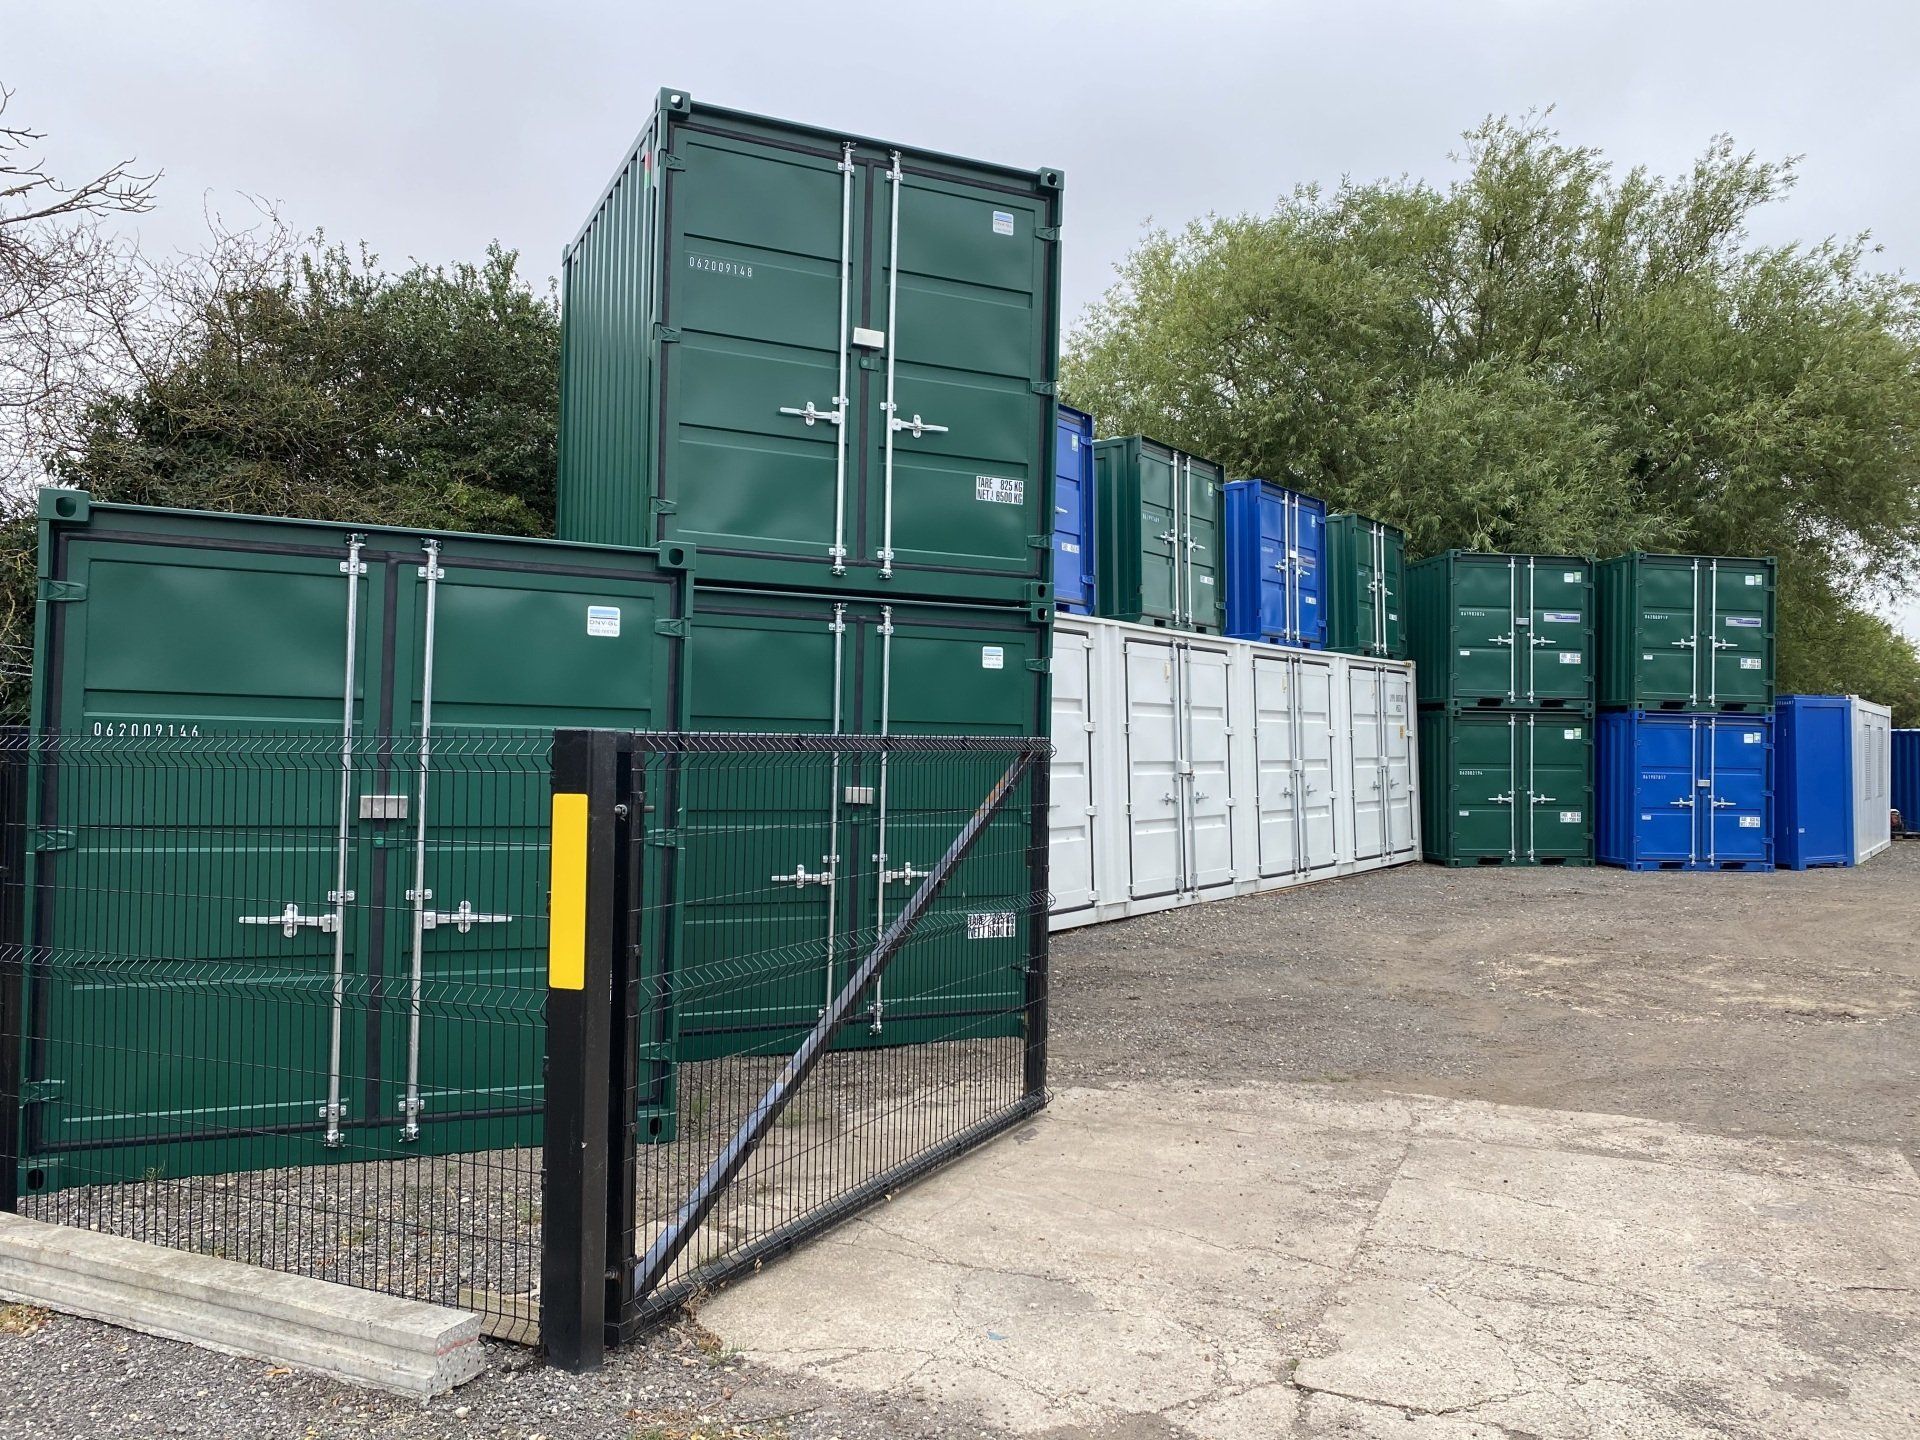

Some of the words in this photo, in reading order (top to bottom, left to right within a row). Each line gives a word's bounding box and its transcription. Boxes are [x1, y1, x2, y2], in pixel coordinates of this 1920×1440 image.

[689, 256, 753, 277] 062009148
[977, 476, 993, 489] TARE
[1000, 479, 1013, 491] 825
[995, 490, 1013, 502] 6500
[93, 721, 199, 737] 062009146
